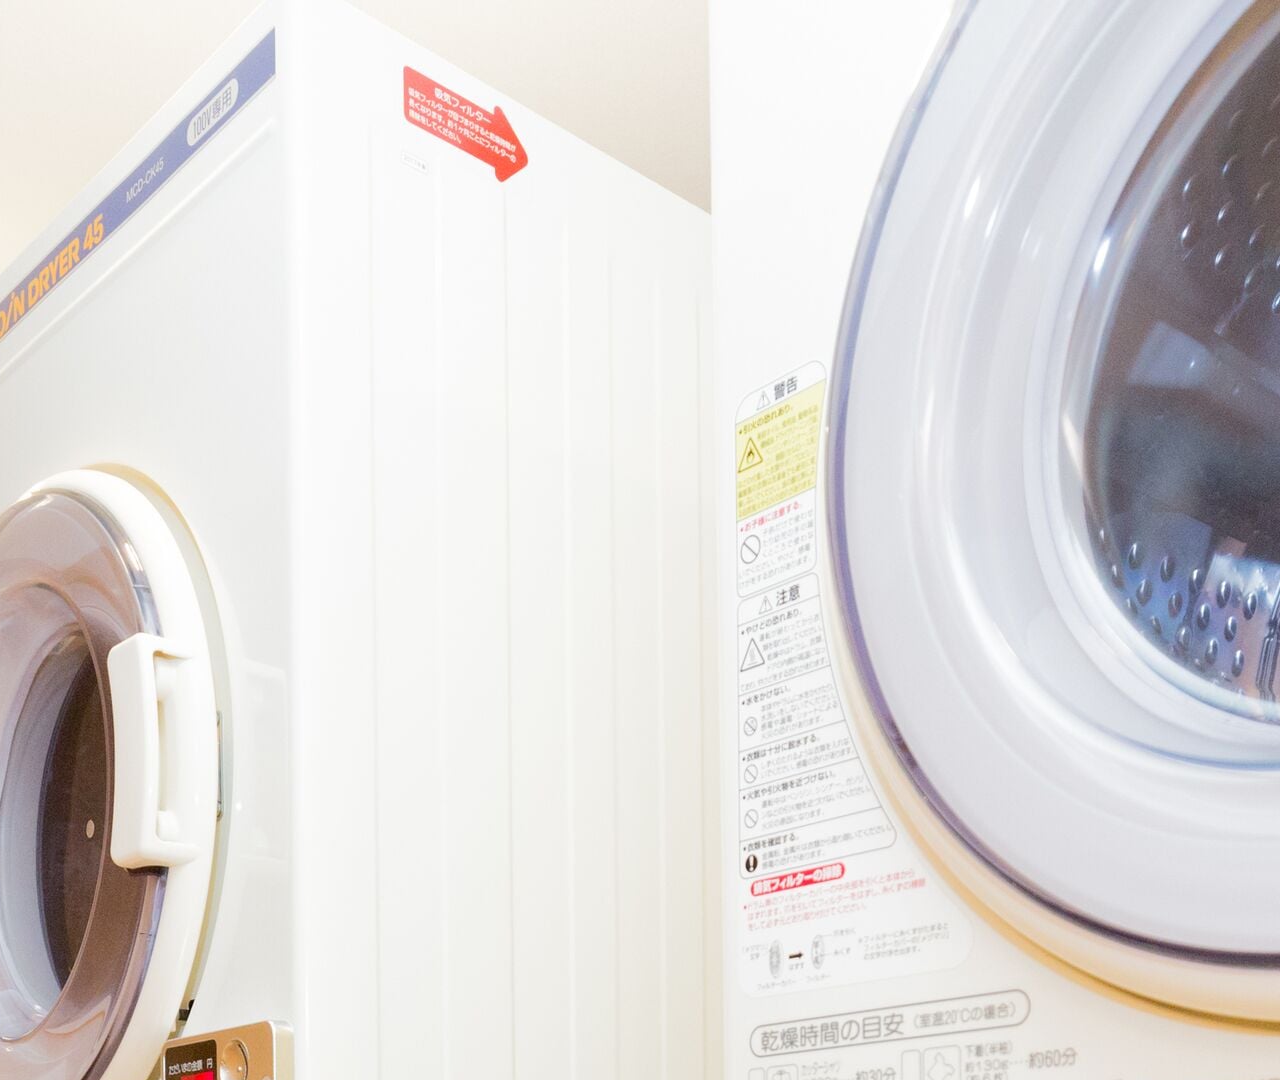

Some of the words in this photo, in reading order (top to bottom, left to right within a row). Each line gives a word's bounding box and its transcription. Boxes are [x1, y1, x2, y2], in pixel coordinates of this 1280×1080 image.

[28, 237, 81, 309] DRYER
[83, 212, 104, 250] 45
[776, 584, 800, 607] 注意
[761, 1014, 904, 1053] 乾燥時間の目安
[1028, 1048, 1078, 1069] 約60分
